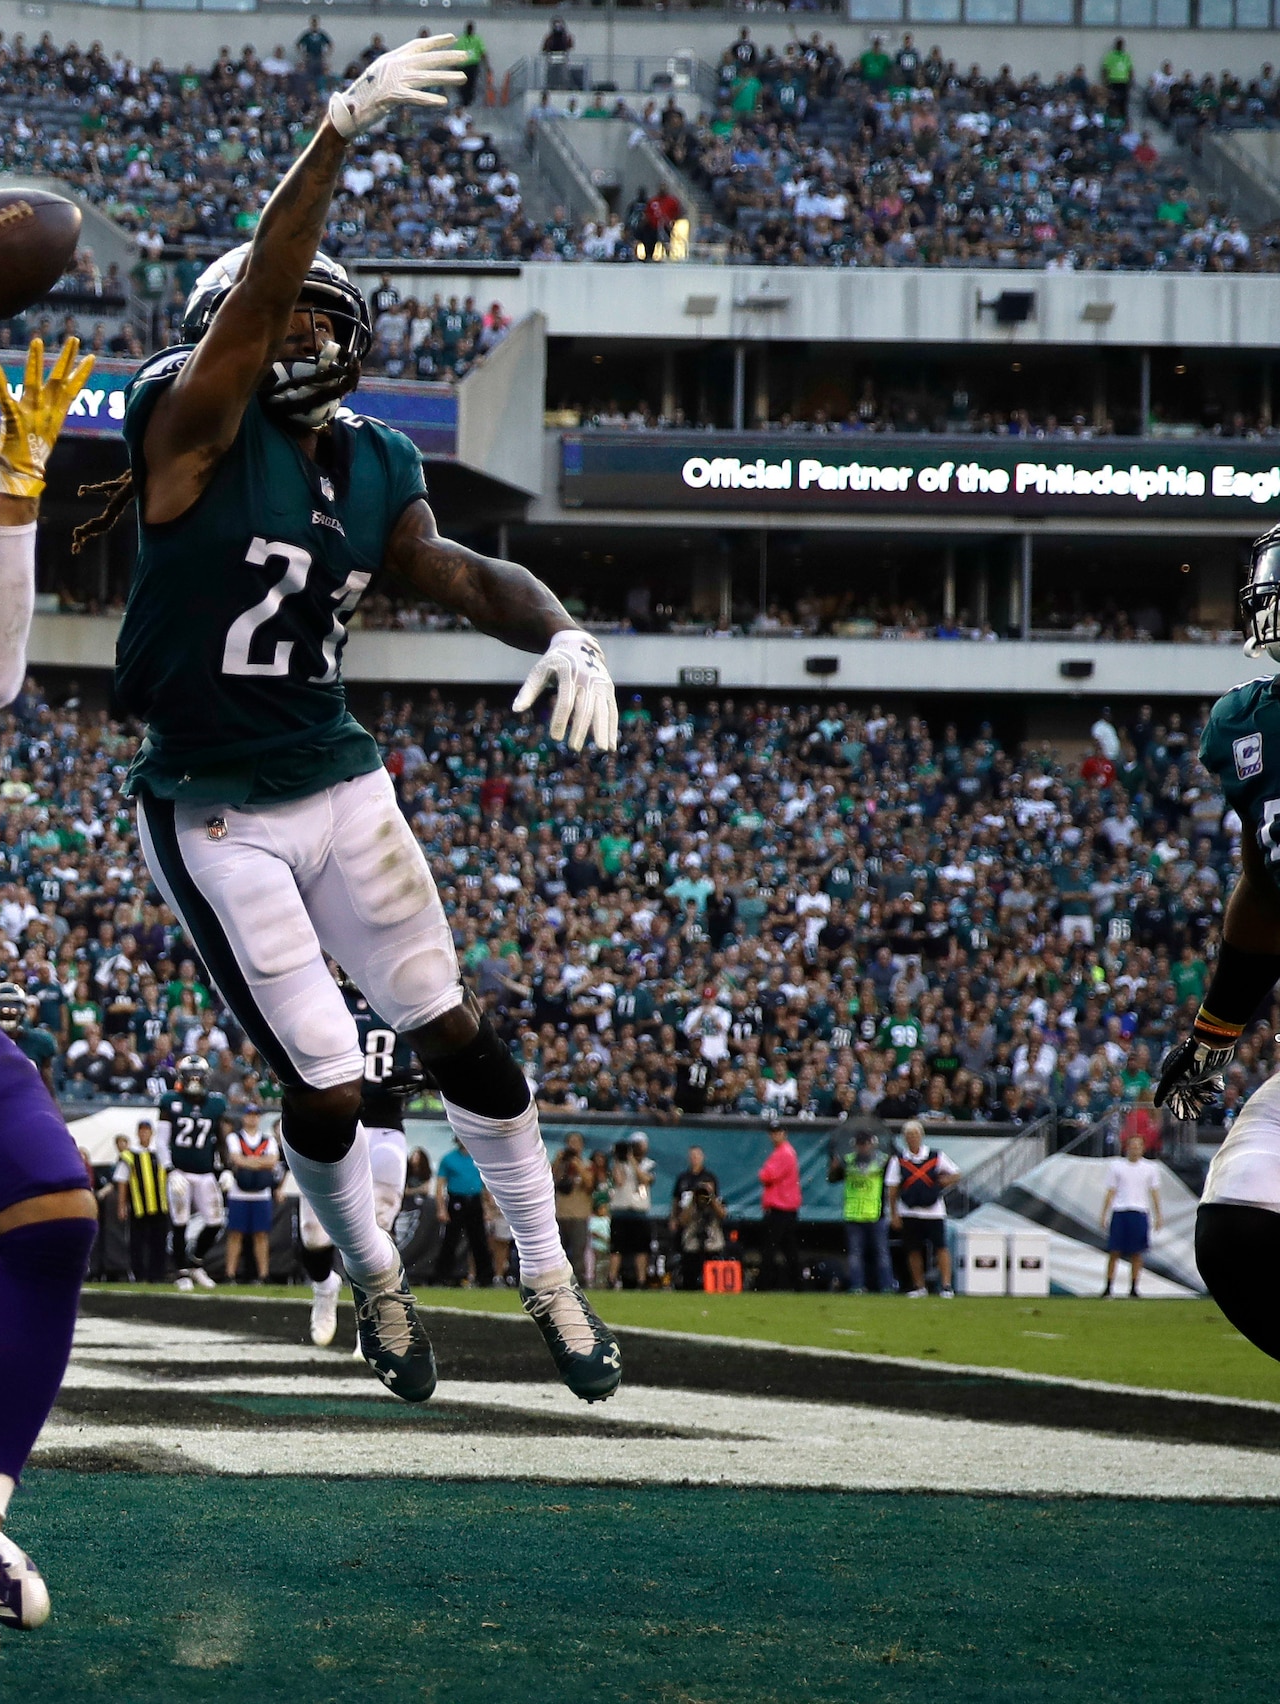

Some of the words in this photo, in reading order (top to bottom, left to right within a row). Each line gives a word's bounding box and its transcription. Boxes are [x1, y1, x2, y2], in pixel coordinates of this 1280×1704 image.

[682, 457, 792, 489] Official
[799, 459, 913, 491] Partner
[918, 461, 955, 492] of
[956, 462, 1010, 494] the
[1015, 462, 1205, 501] Philadelphia
[175, 1117, 212, 1149] 27
[711, 1264, 736, 1290] 10
